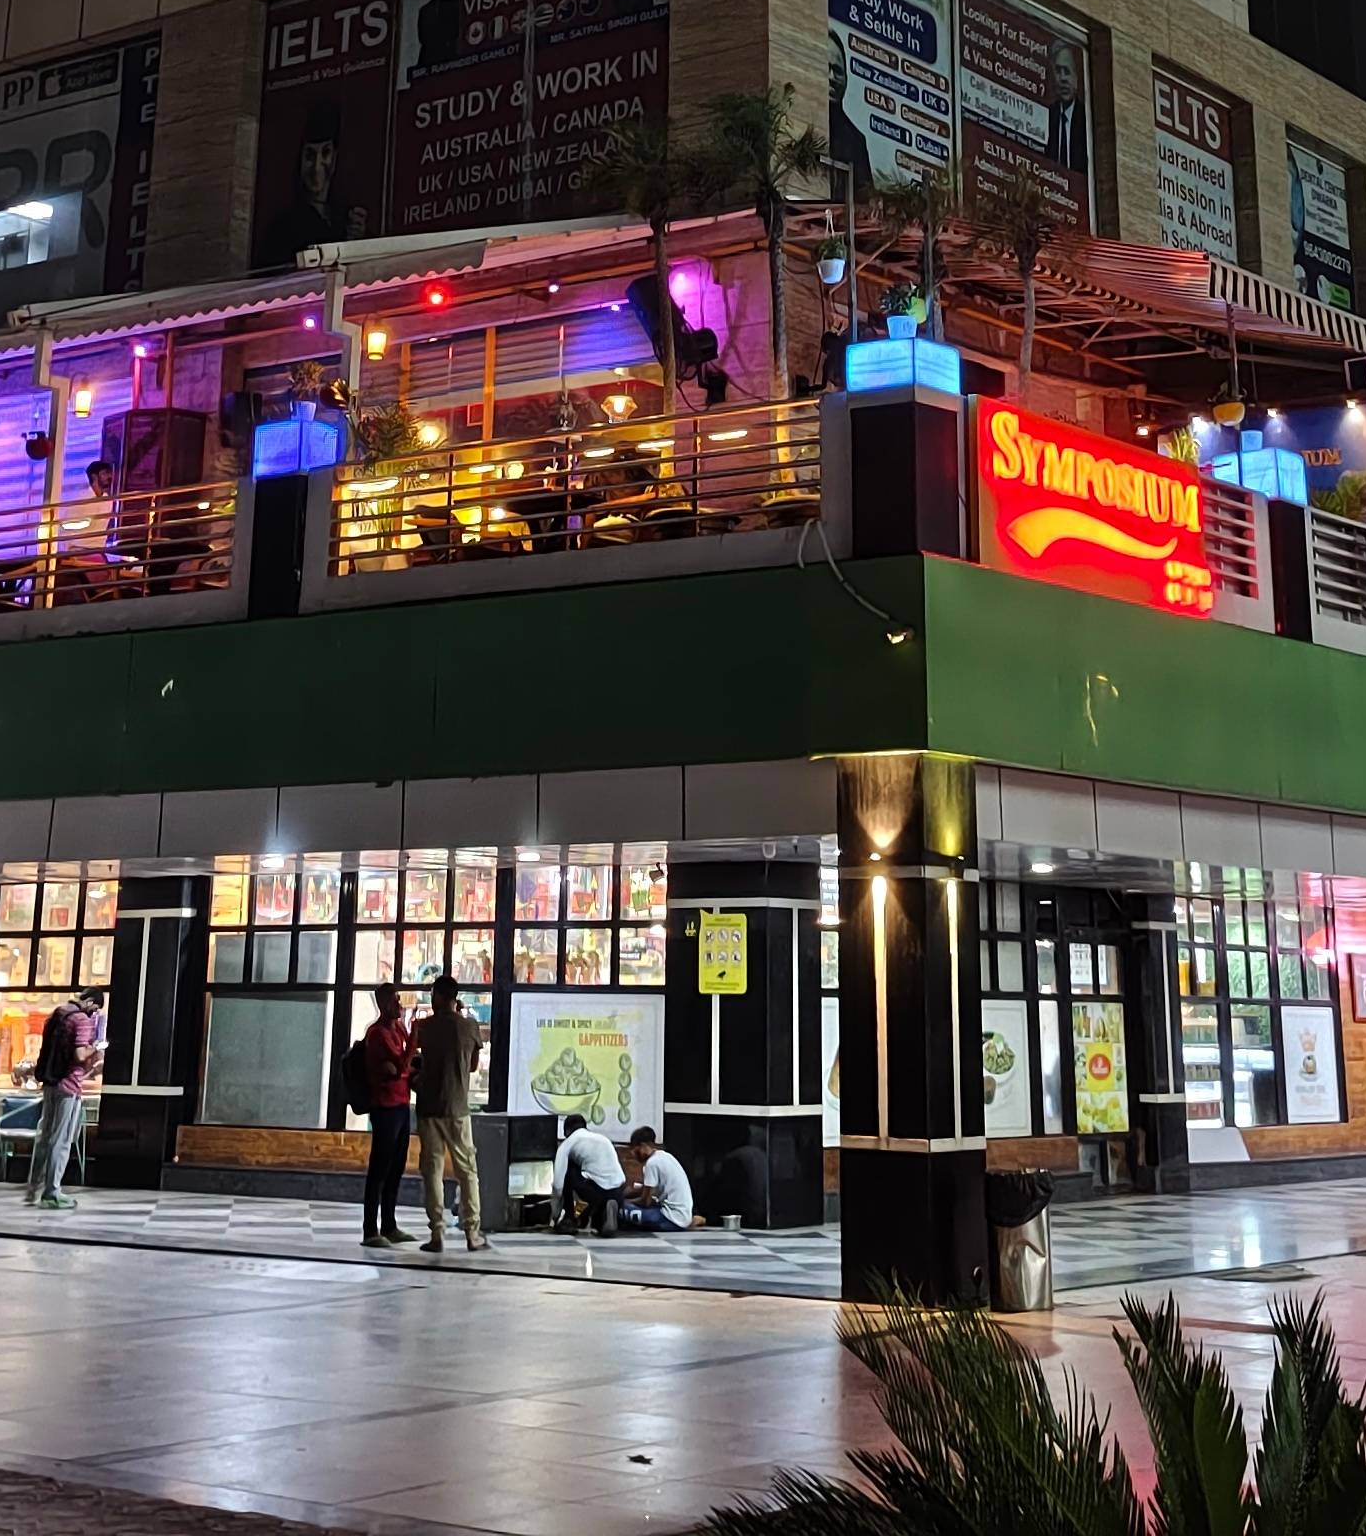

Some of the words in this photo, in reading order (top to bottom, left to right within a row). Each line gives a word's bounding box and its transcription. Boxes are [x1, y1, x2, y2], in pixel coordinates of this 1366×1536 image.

[268, 0, 389, 71] IELTS
[849, 5, 860, 24] &
[864, 11, 903, 44] Settle
[908, 31, 920, 53] In
[888, 0, 924, 32] Work
[414, 82, 503, 129] STUDY
[510, 79, 527, 106] &
[536, 54, 623, 101] WORK
[631, 47, 659, 78] IN
[420, 120, 535, 164] AUSTRALIA
[553, 96, 644, 134] CANADA
[418, 173, 443, 194] UK
[458, 162, 494, 186] USA
[509, 147, 550, 177] NEW
[555, 135, 629, 165] ZEALA
[403, 192, 480, 225] IRELAND
[496, 178, 552, 205] DUBAI
[1178, 206, 1187, 226] &
[1190, 213, 1233, 247] Abroad
[991, 411, 1201, 532] SYMPOSIUM
